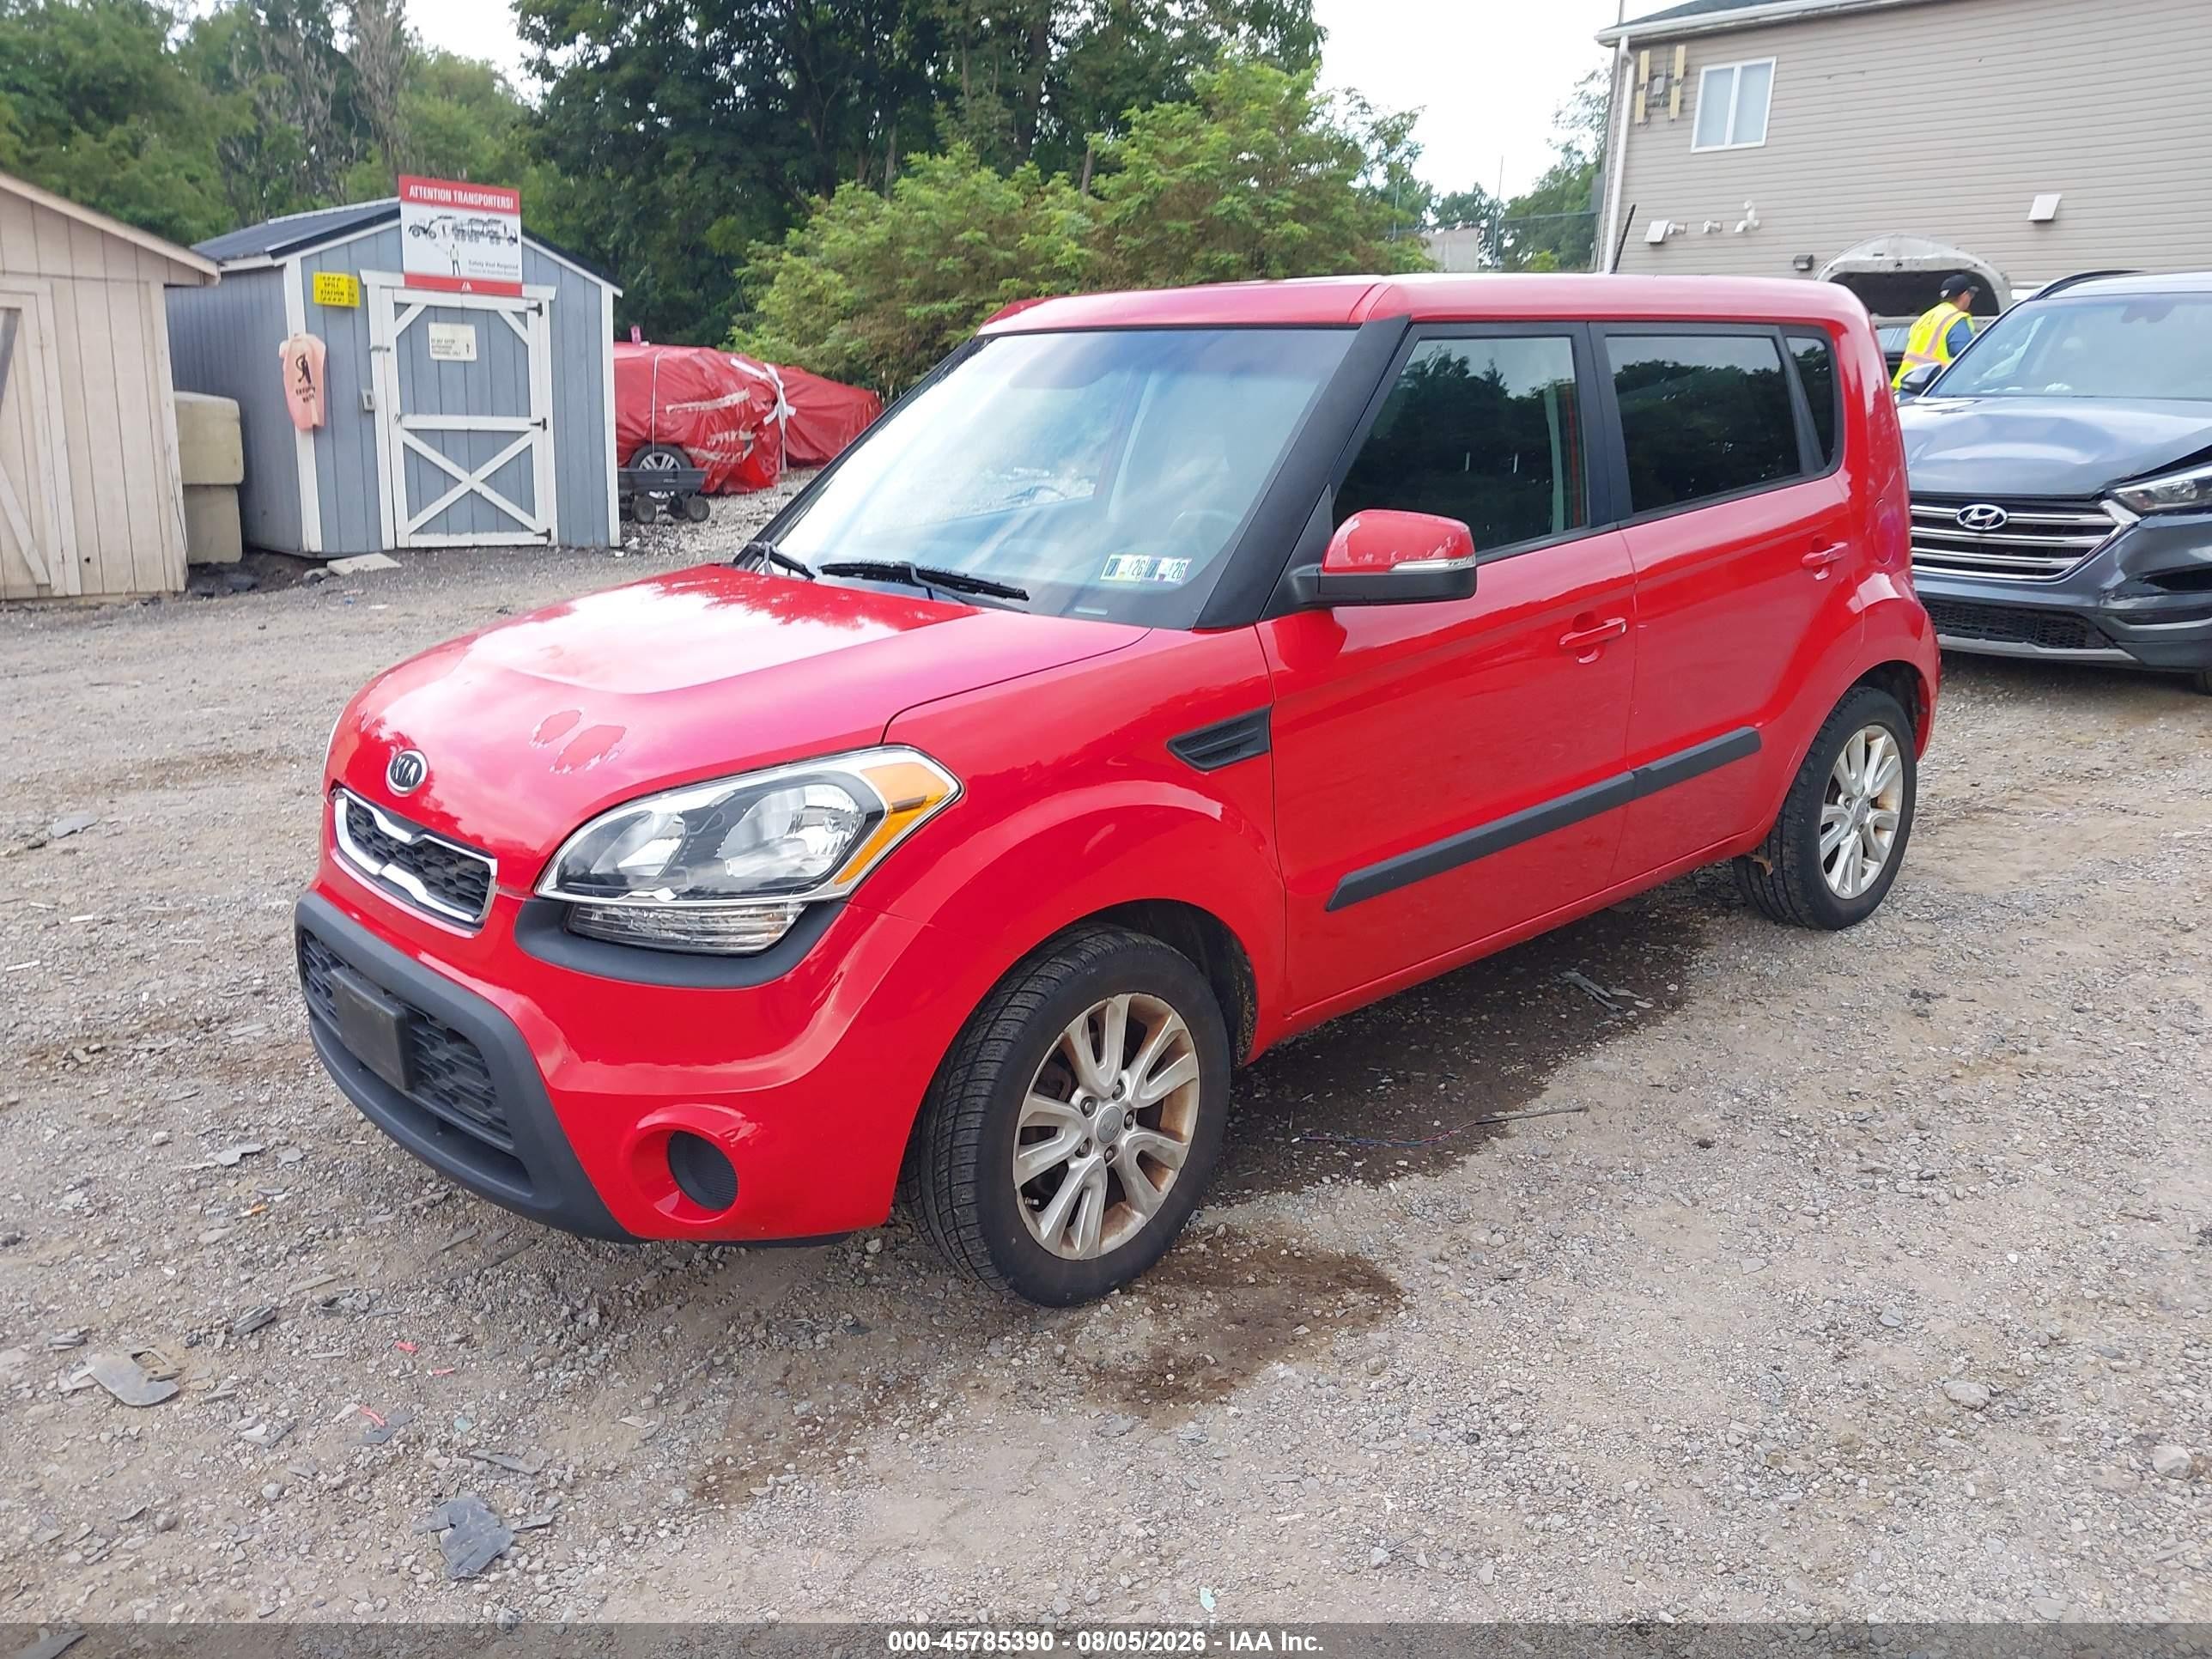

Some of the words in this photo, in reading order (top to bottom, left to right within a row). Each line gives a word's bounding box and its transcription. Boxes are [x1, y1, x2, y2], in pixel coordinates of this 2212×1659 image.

[409, 185, 452, 203] ATTENTION
[453, 190, 514, 210] TRANSPORTERS!
[320, 289, 345, 297] STATION
[392, 755, 419, 787] KIA
